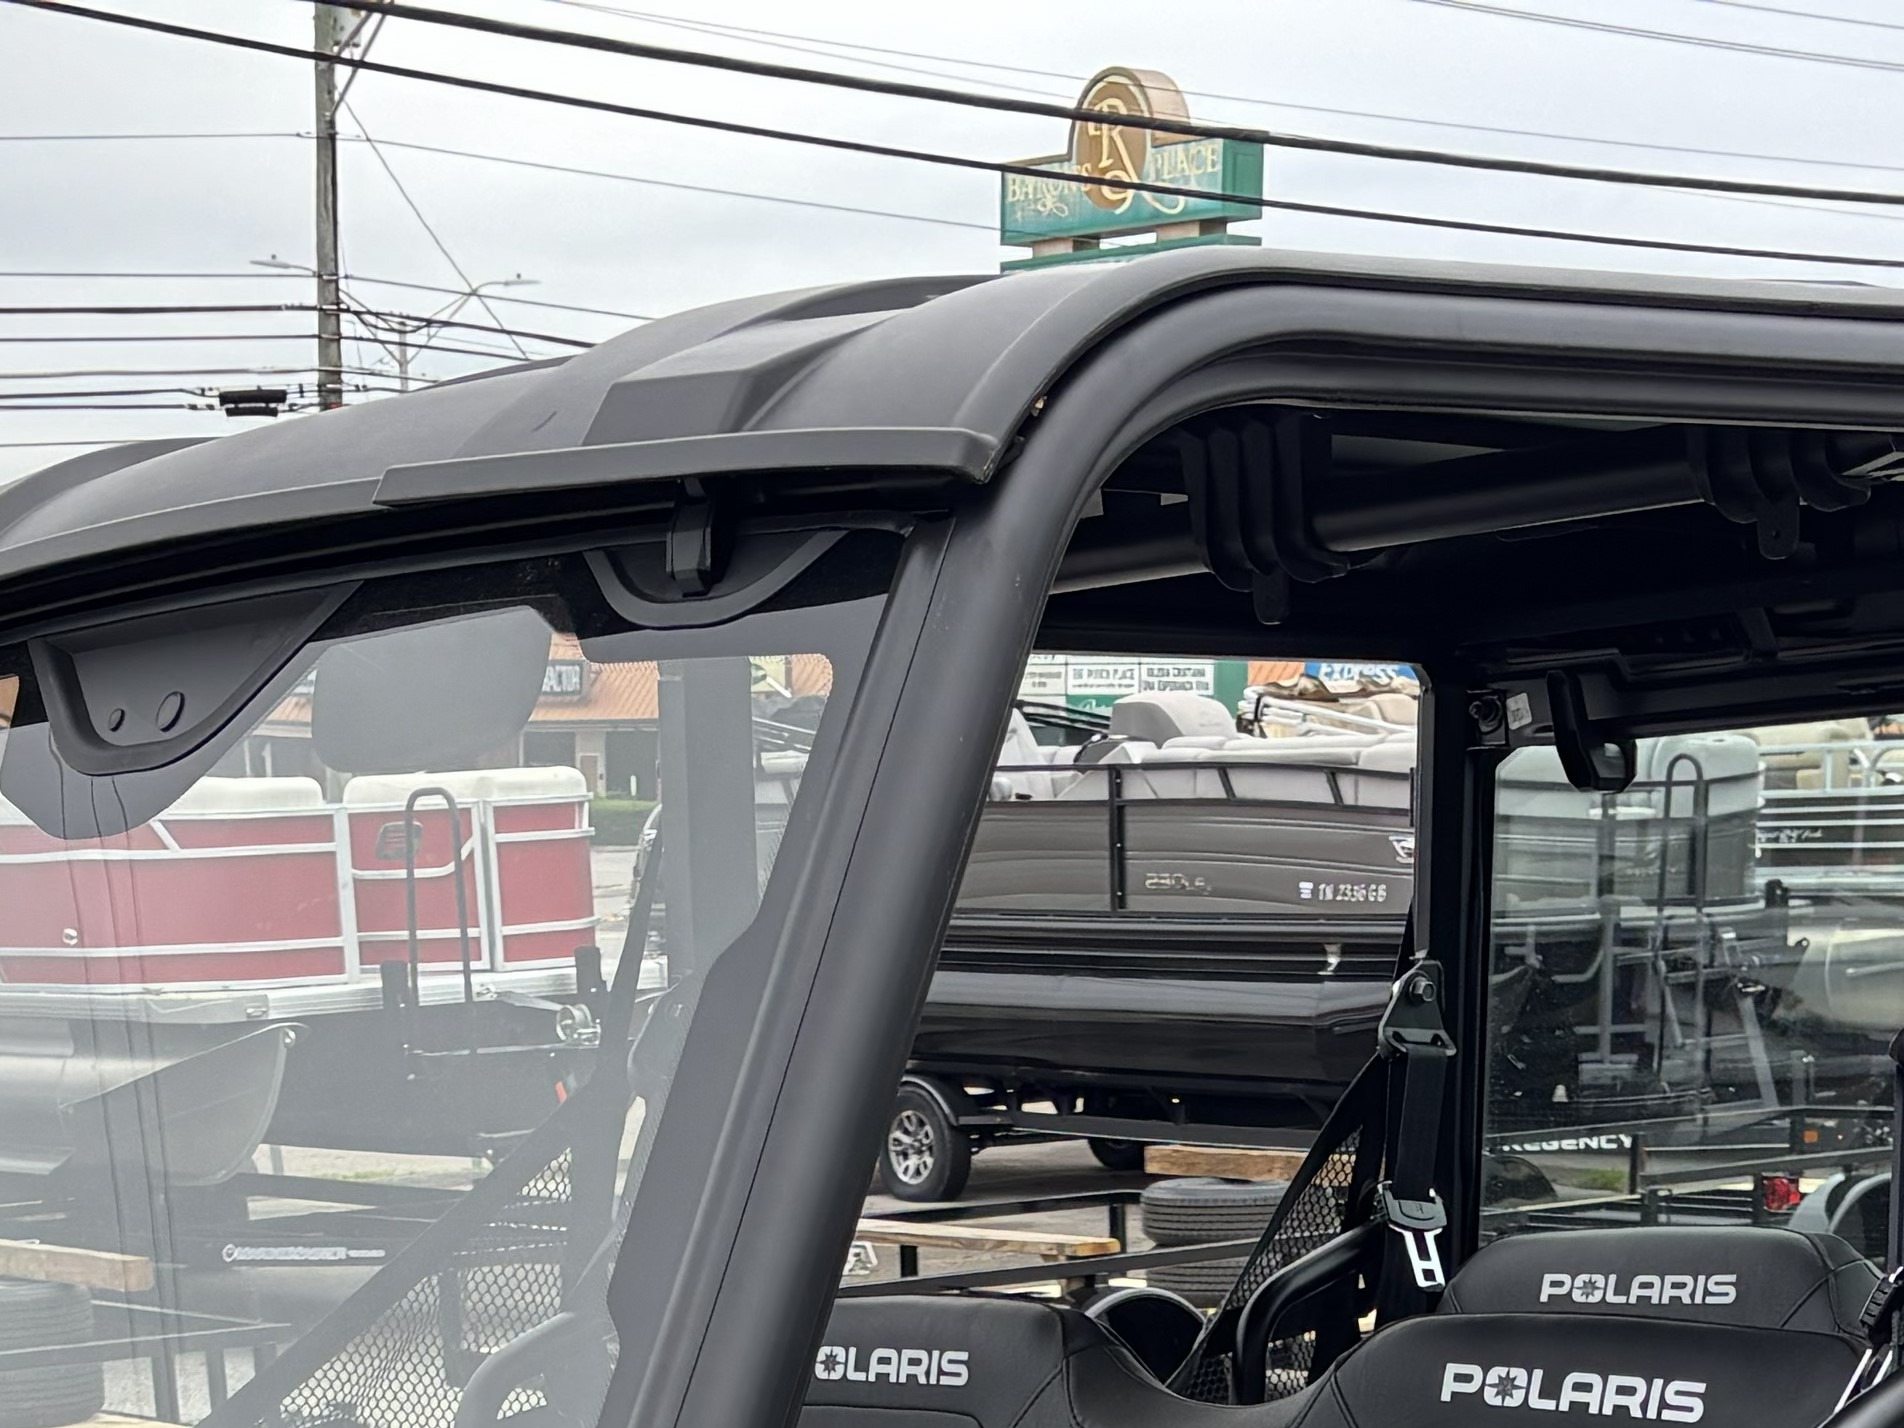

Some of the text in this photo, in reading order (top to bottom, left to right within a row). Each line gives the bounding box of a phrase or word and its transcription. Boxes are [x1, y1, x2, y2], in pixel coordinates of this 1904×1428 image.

[1147, 143, 1220, 182] PLACE
[1538, 1272, 1738, 1306] POLARIS
[1439, 1361, 1708, 1425] POLARIS
